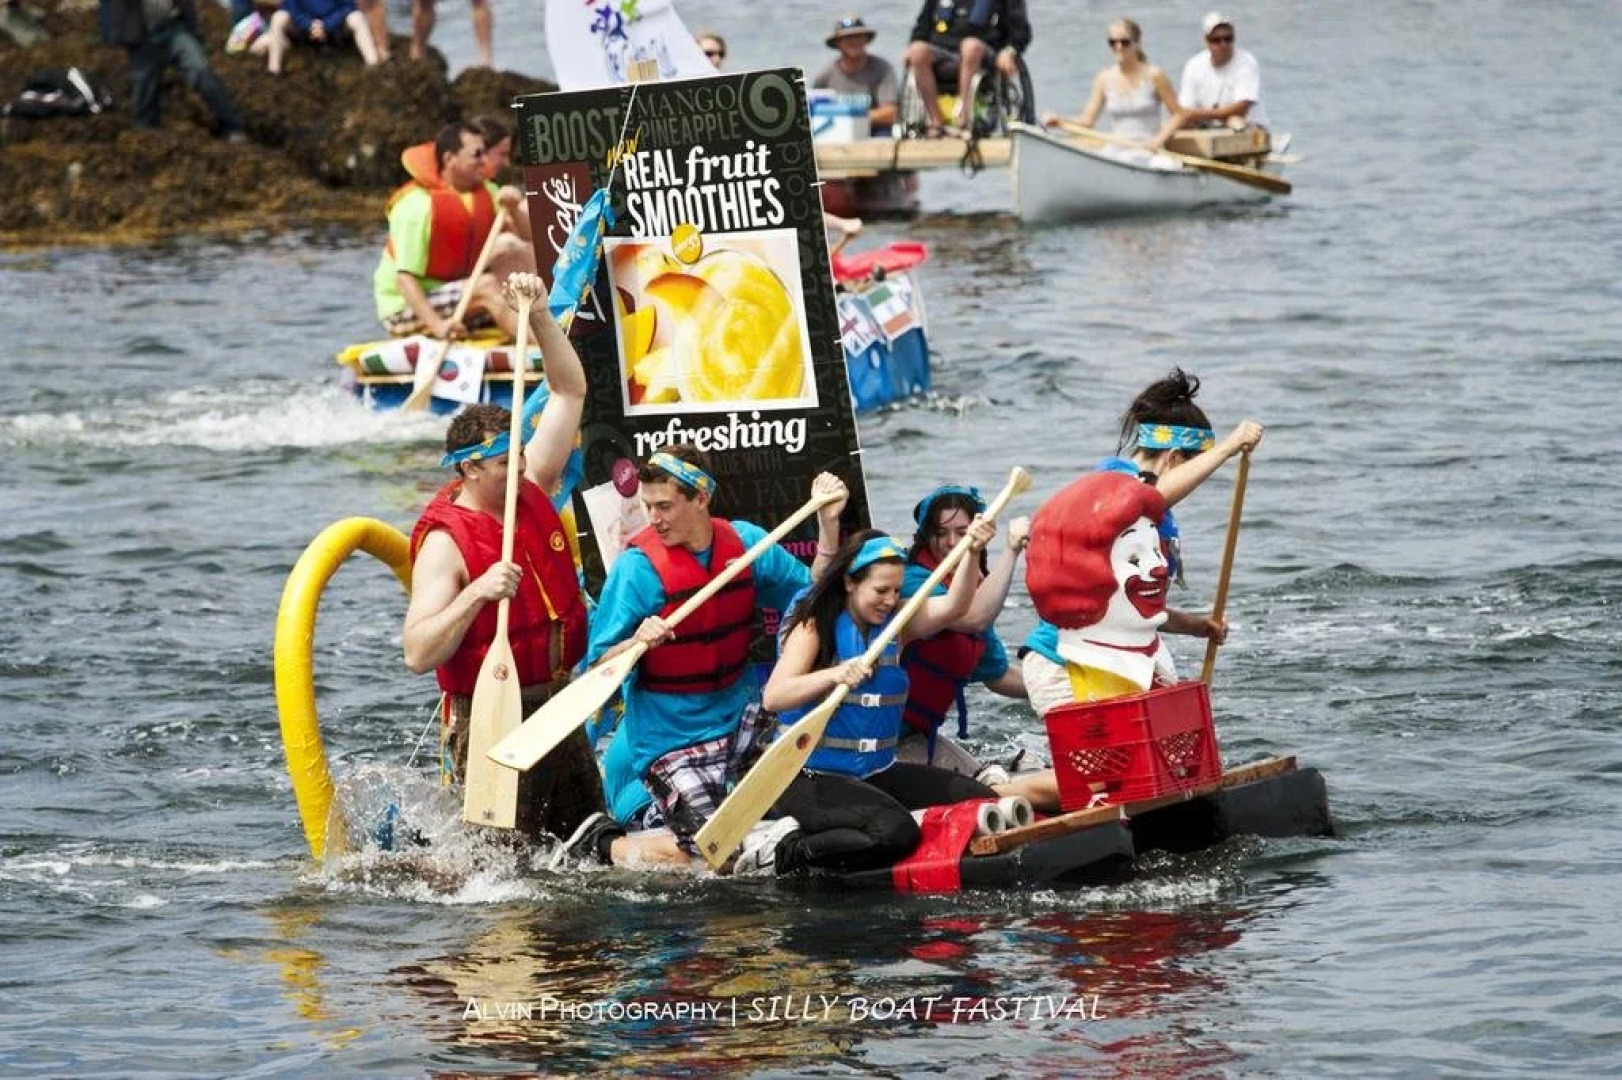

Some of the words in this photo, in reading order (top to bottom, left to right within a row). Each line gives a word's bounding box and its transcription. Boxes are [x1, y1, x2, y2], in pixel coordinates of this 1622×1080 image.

[634, 84, 736, 118] MANGO
[534, 107, 619, 163] BOOST
[642, 109, 743, 149] PINEAPPLE
[622, 148, 684, 191] REAL
[685, 140, 772, 196] fruit
[626, 179, 785, 237] SMOOTHIES
[633, 410, 807, 457] refreshing
